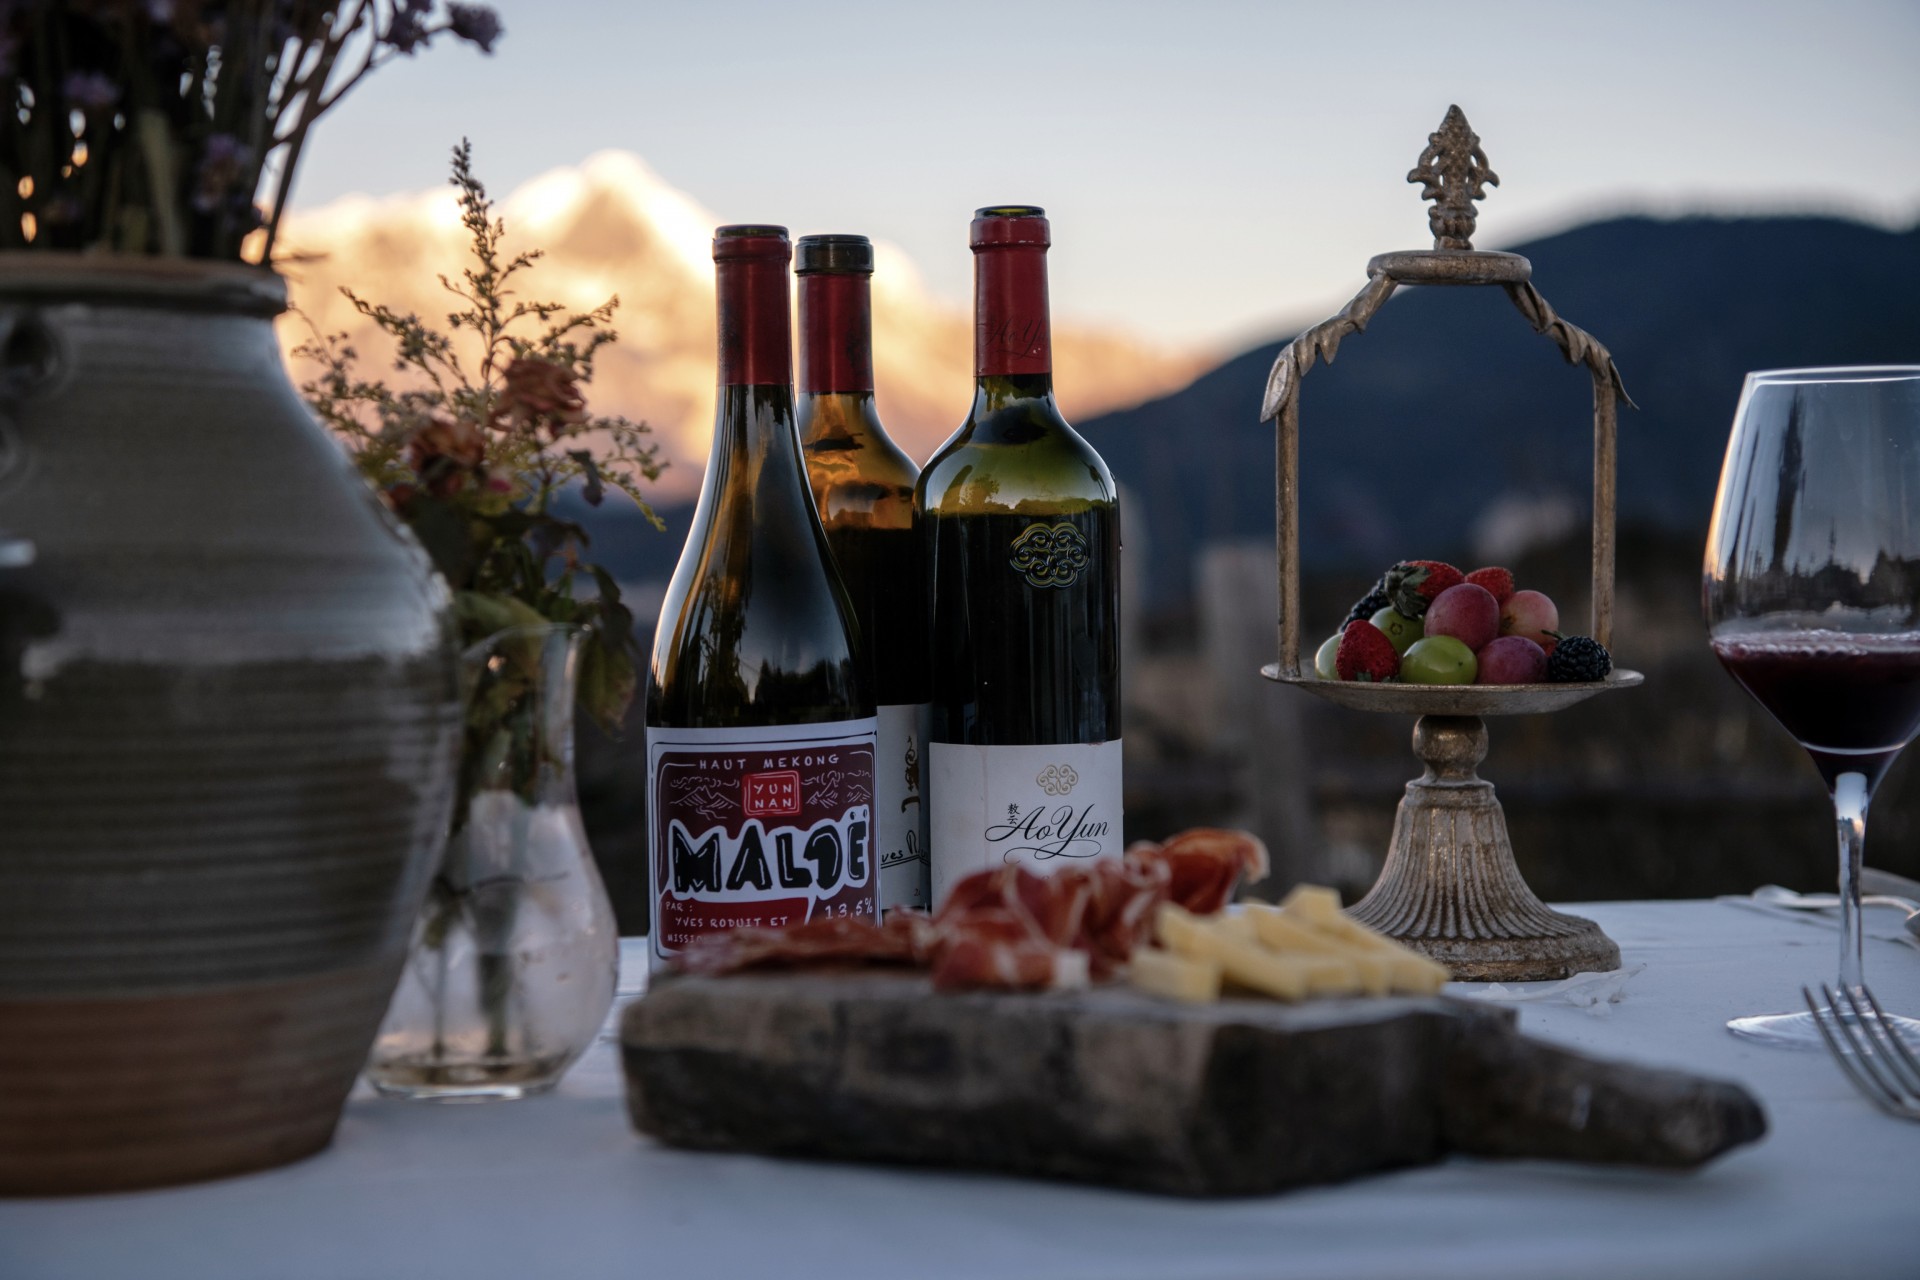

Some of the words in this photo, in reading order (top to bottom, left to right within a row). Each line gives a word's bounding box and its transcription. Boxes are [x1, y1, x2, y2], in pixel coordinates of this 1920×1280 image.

[700, 758, 747, 770] HAUT
[763, 754, 839, 769] MEKONG
[753, 784, 792, 795] YUN
[754, 798, 792, 808] NAN
[881, 850, 903, 863] ves
[665, 902, 683, 912] PAR
[675, 917, 703, 927] YVES
[710, 918, 761, 928] RODUIT
[770, 916, 788, 926] ET
